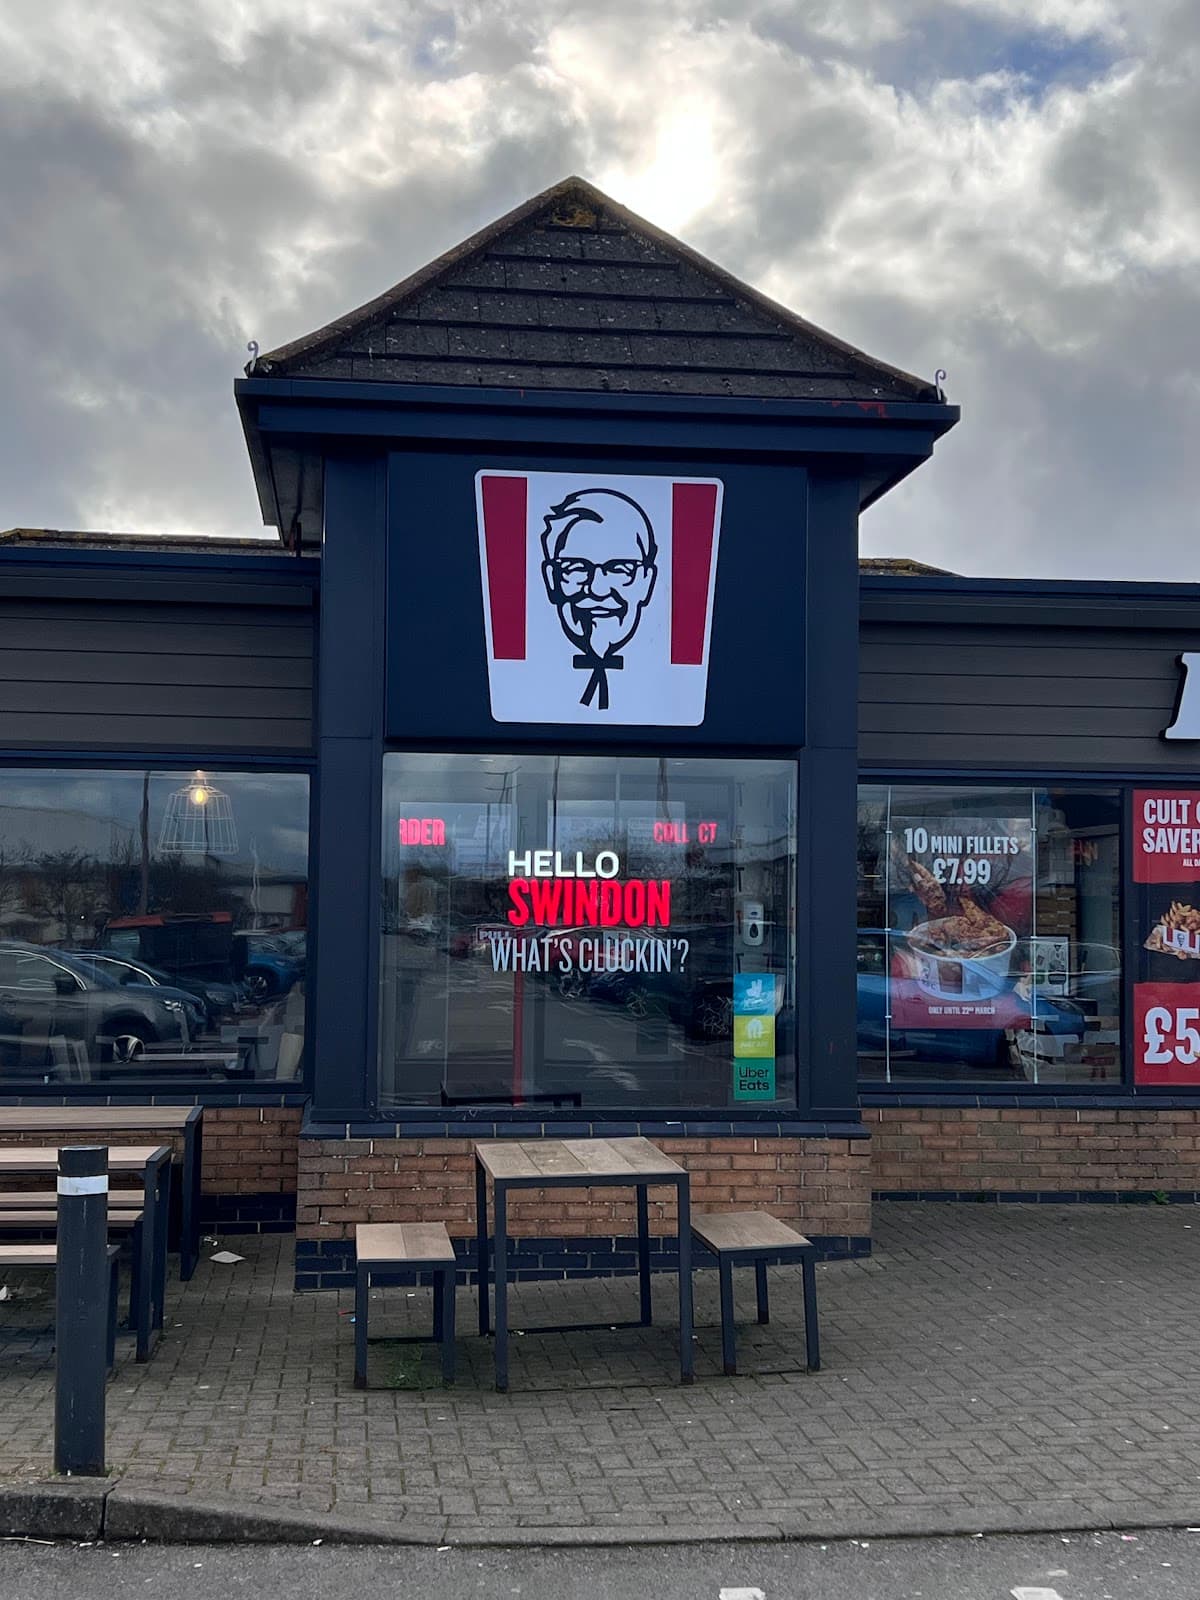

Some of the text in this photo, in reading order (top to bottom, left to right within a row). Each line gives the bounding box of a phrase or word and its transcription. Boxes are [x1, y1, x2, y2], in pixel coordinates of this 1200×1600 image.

[1143, 799, 1191, 825] CULT
[904, 827, 1019, 855] 10 MINI FILLETS
[508, 850, 620, 879] HELLO
[932, 858, 991, 885] £7.99
[508, 878, 670, 927] SWINDON
[491, 938, 690, 973] WHAT'S CLUCKIN'?
[739, 1067, 769, 1078] Uber
[739, 1080, 770, 1091] Eats
